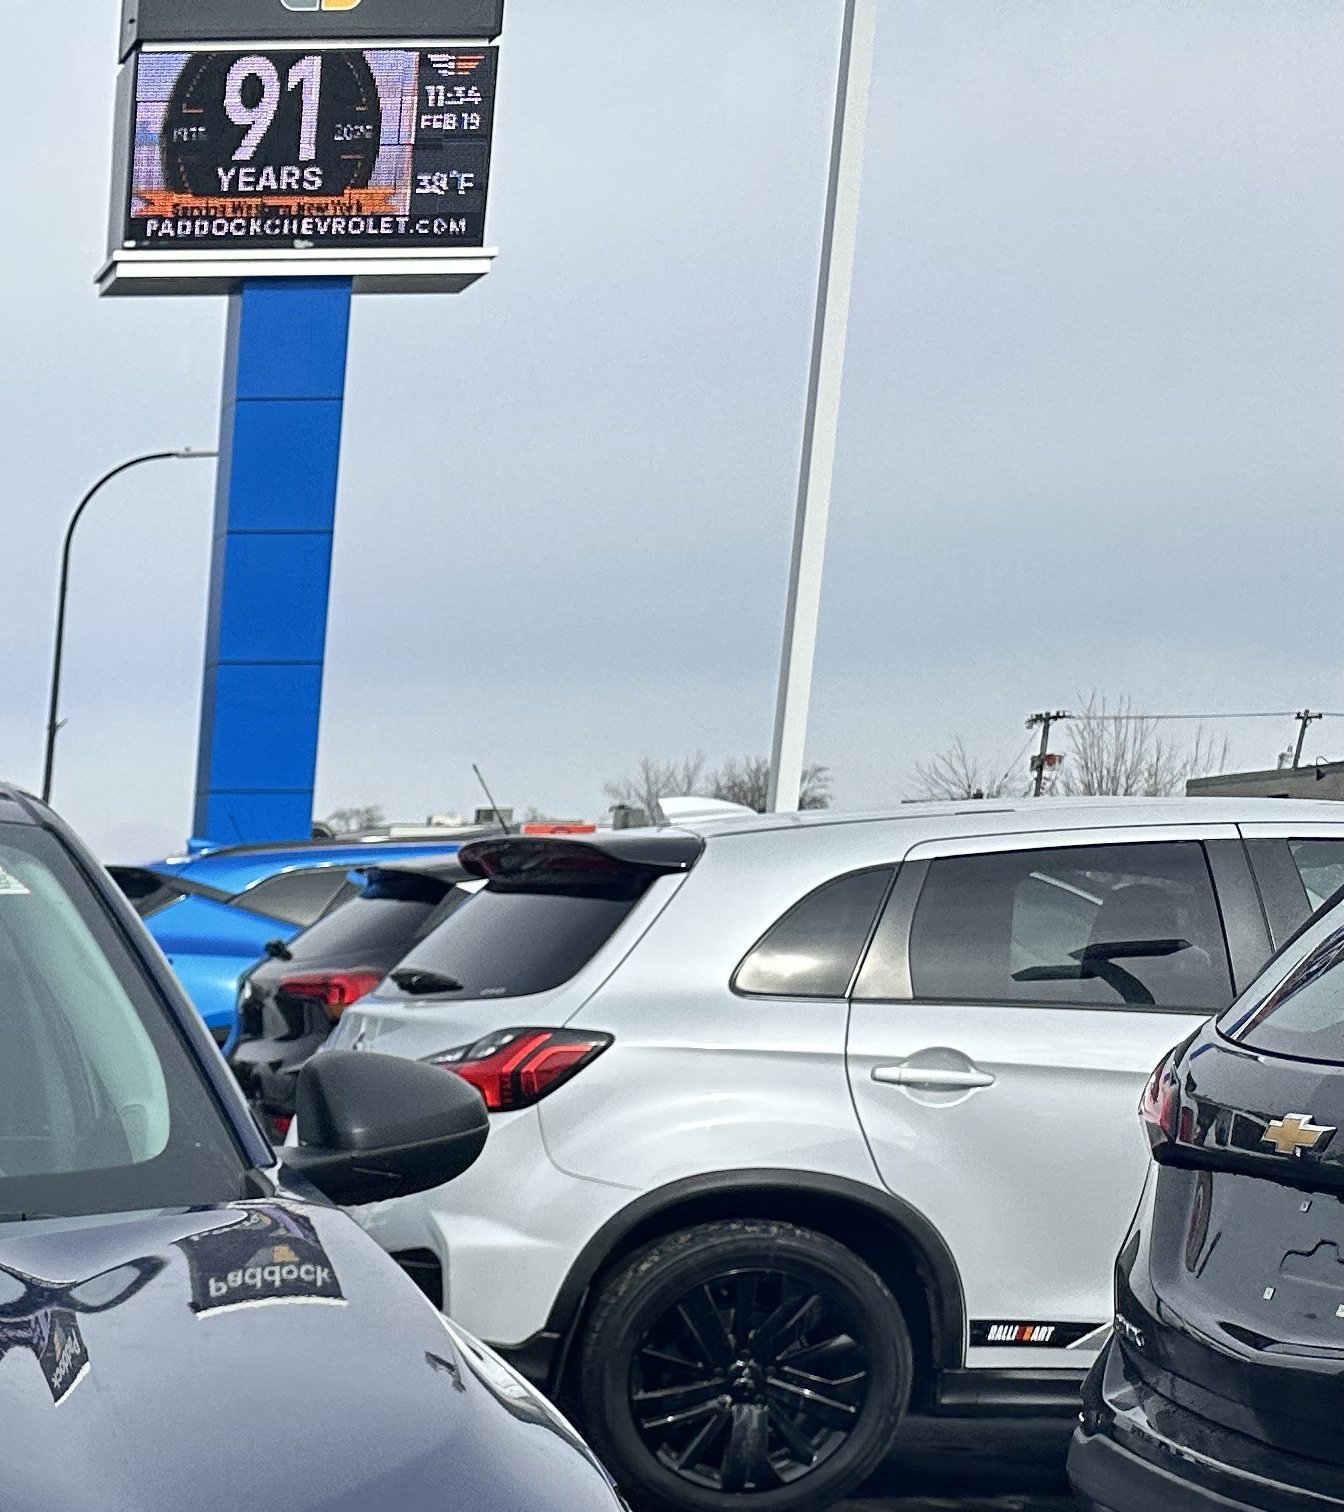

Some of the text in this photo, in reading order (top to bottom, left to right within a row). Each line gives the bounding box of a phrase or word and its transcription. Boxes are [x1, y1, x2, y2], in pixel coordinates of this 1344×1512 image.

[223, 54, 321, 161] 91
[420, 113, 457, 130] FEB
[461, 112, 480, 130] 19
[217, 165, 323, 192] YEARS
